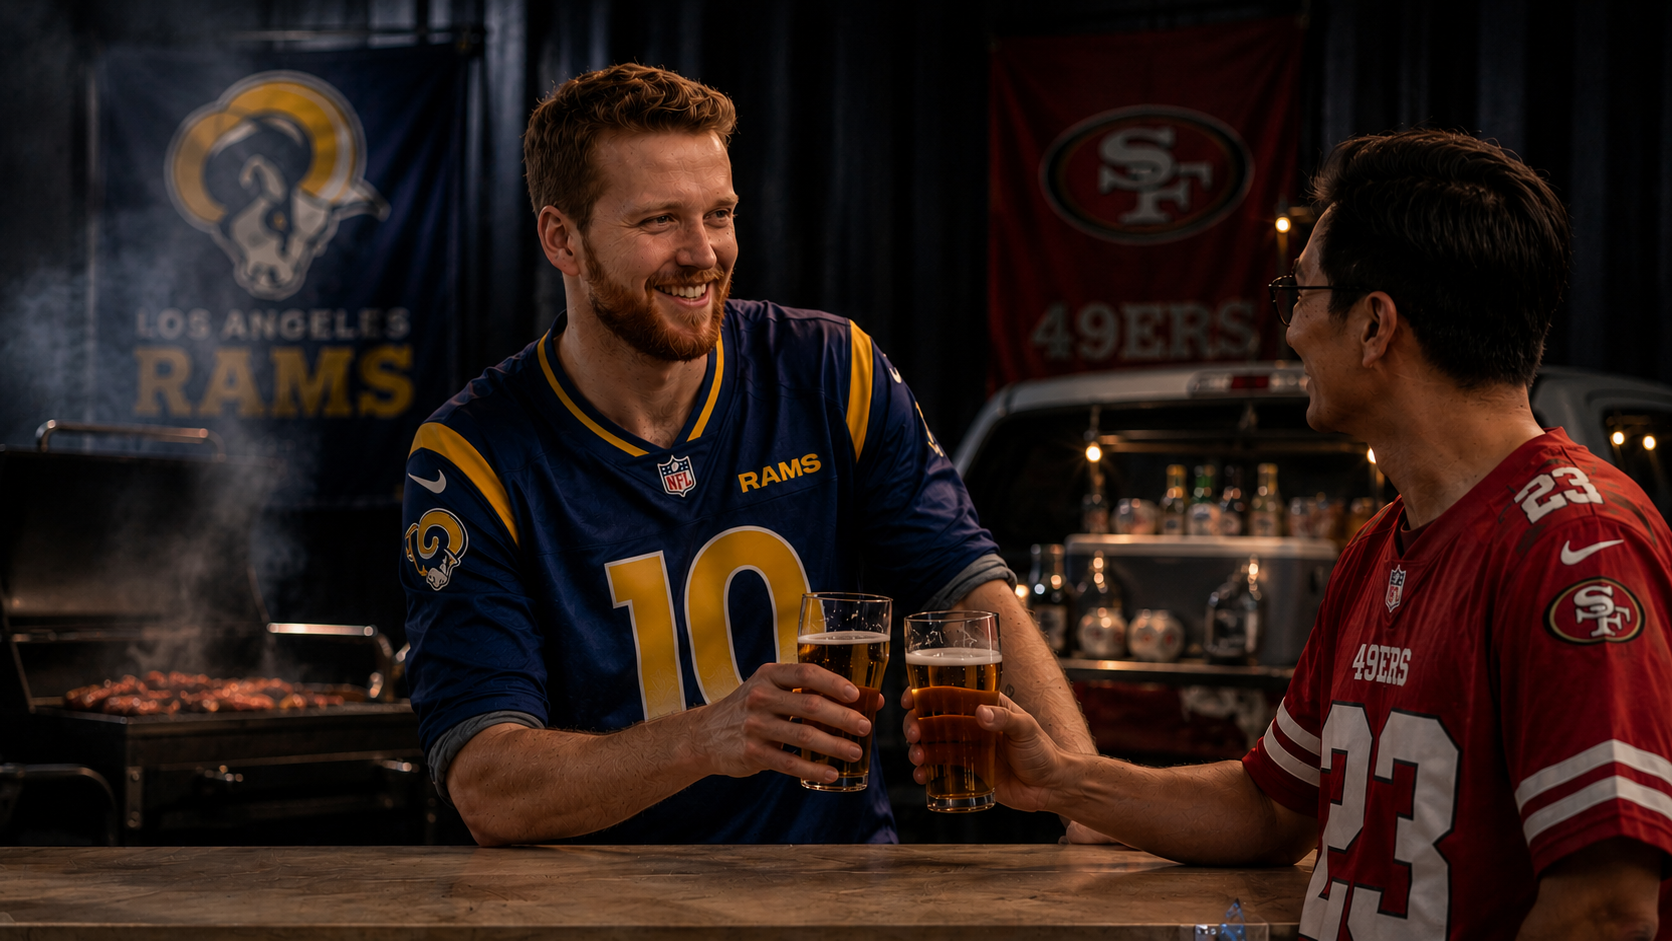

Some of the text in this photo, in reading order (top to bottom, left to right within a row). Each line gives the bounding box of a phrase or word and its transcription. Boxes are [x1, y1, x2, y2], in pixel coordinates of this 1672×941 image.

[1097, 126, 1213, 225] SF
[135, 307, 411, 341] LOS ANGELES
[1031, 299, 1258, 361] 49ERS
[133, 343, 415, 418] RAMS
[737, 453, 823, 493] RAMS
[1513, 466, 1605, 525] 23
[603, 525, 827, 722] 10
[1572, 584, 1632, 638] SF
[1351, 643, 1413, 687] 49ERS
[1299, 699, 1463, 941] 23
